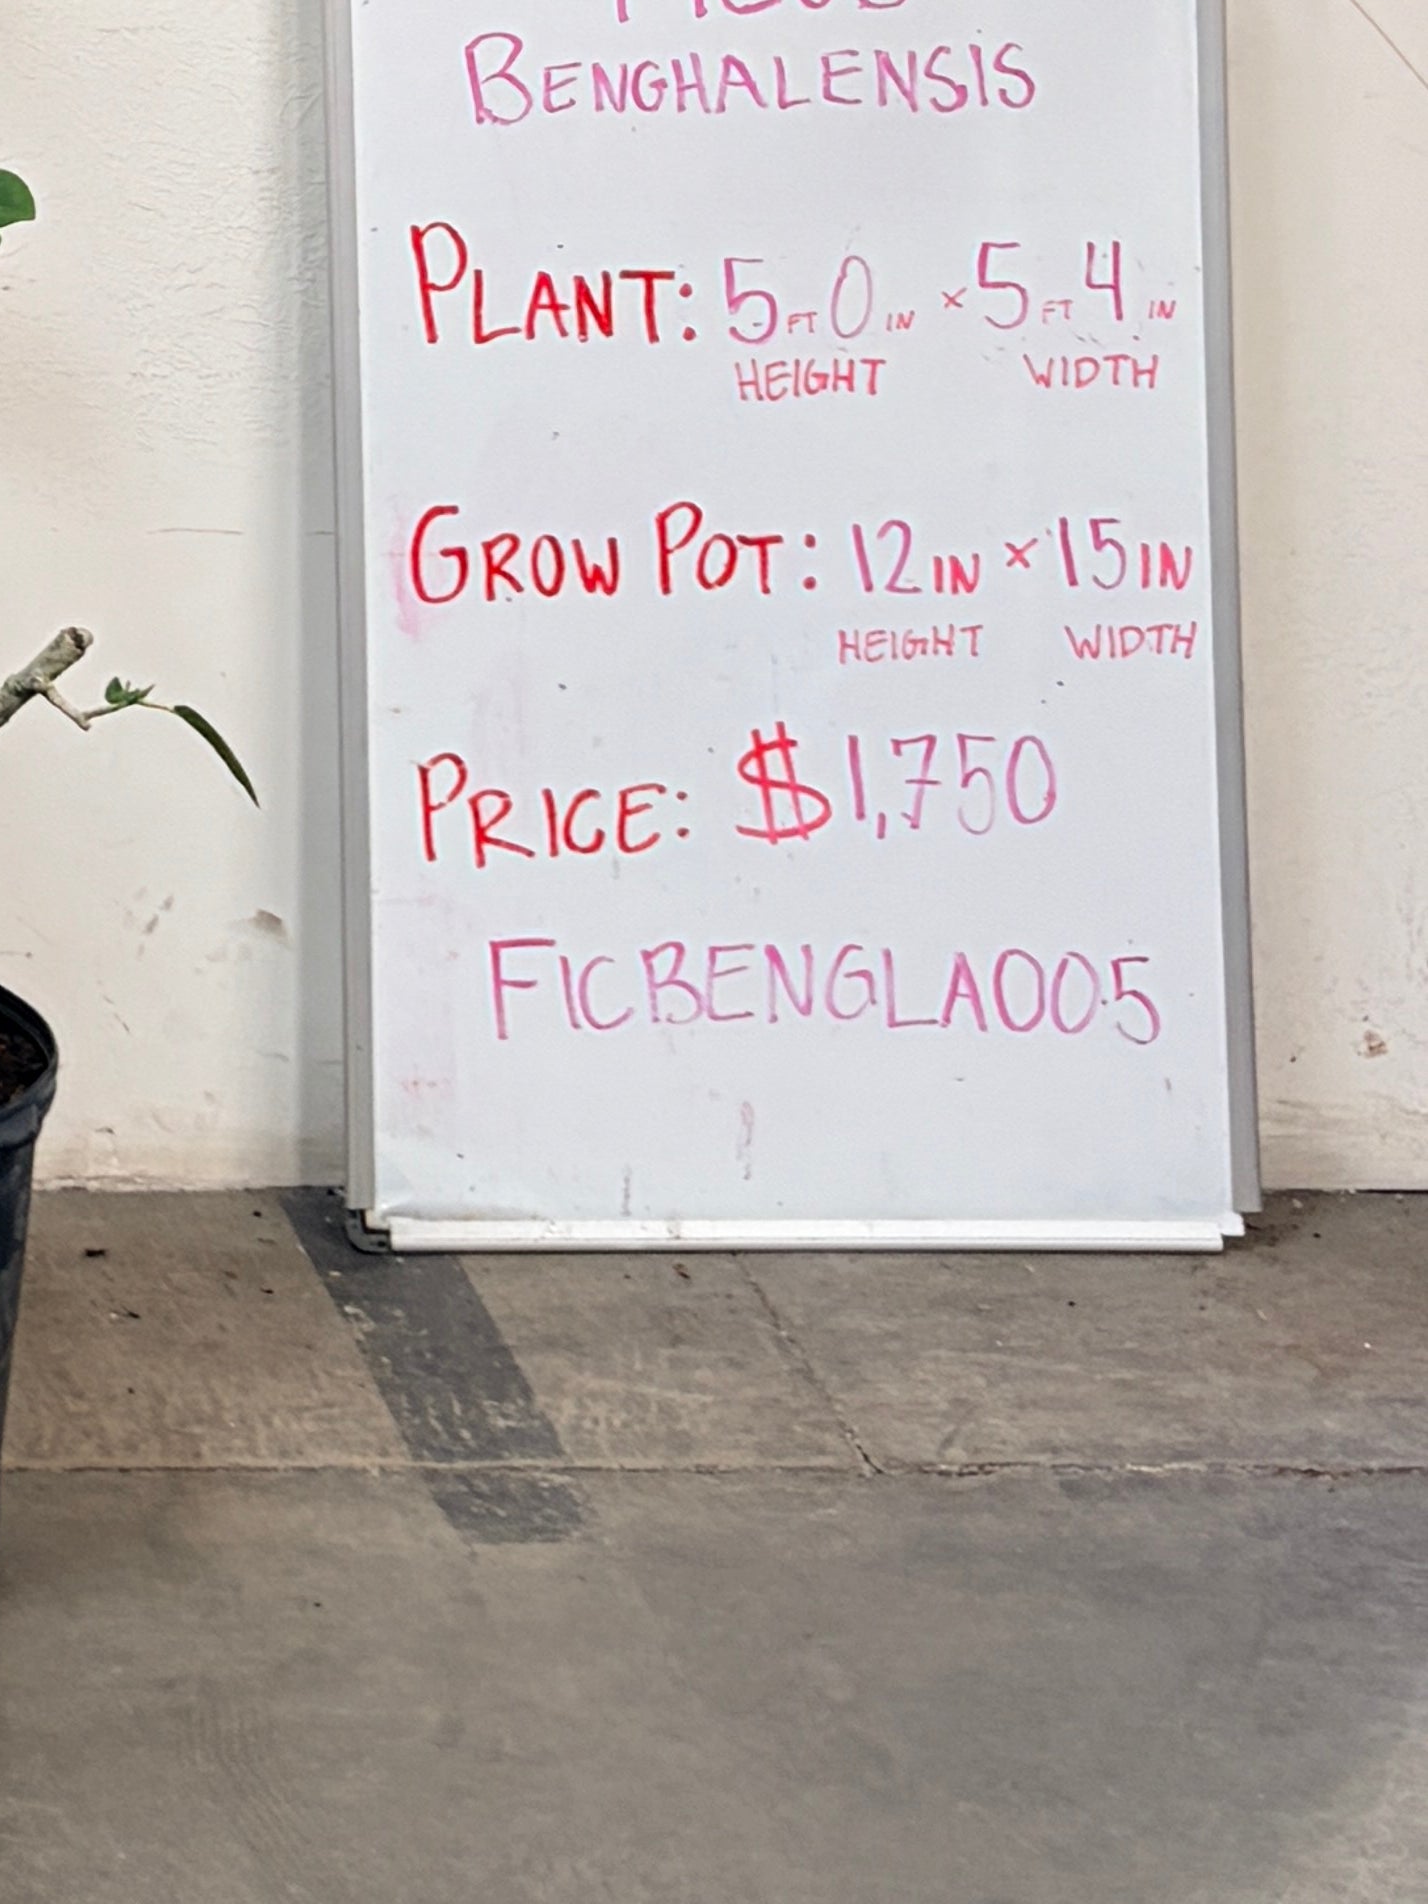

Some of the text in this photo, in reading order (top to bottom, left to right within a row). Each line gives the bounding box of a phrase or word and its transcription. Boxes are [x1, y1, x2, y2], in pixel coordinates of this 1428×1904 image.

[462, 31, 1037, 127] BENGHALENSIS
[407, 221, 698, 347] PLANT:
[735, 351, 1160, 403] HEIGHT WIDTH
[405, 503, 623, 608] GROW
[652, 499, 818, 598] POT:
[836, 622, 1198, 665] HEIGHT WIDTH
[415, 751, 690, 871] PRICE:
[487, 936, 1161, 1042] FICBENGLA005
